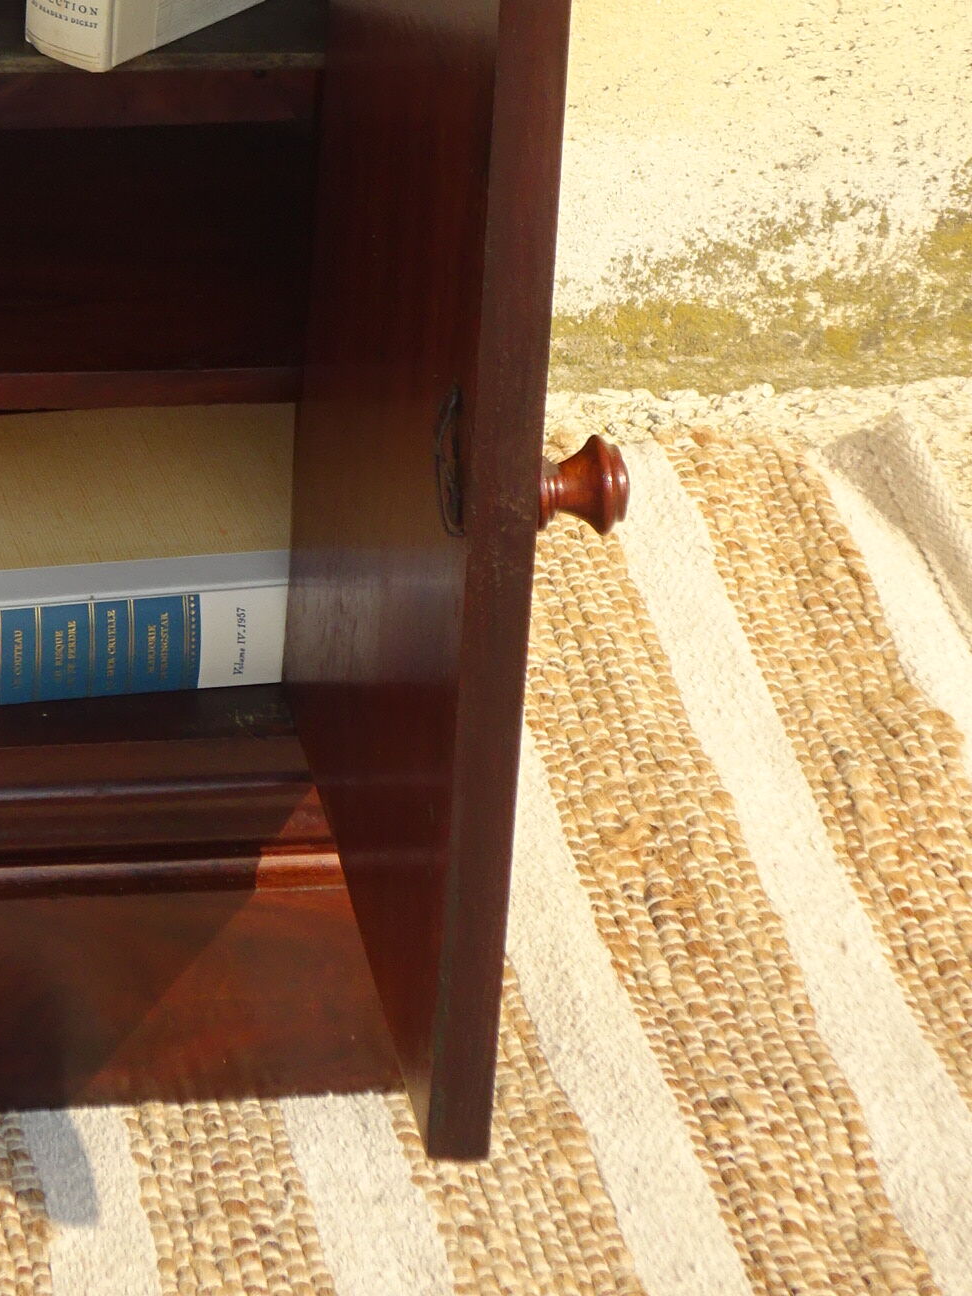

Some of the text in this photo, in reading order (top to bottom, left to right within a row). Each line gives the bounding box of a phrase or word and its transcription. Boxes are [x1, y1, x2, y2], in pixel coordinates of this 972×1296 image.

[70, 17, 98, 29] DIGEST
[14, 630, 23, 676] COUTEAU
[107, 609, 116, 655] CRUELLE
